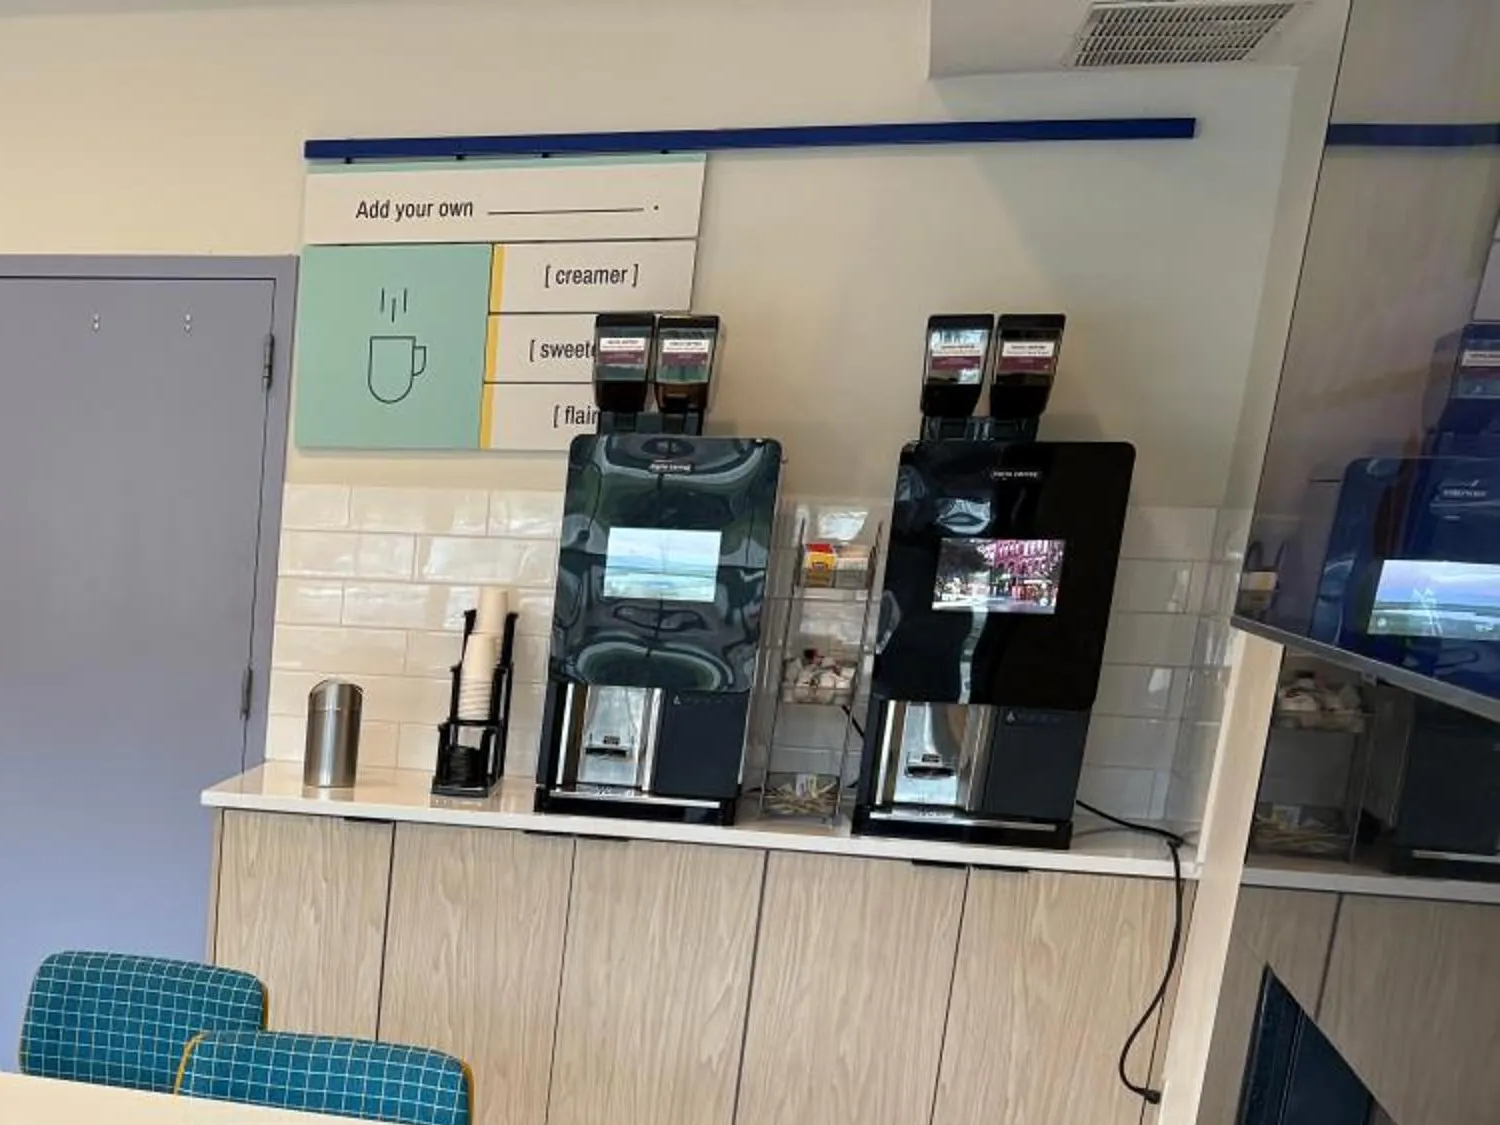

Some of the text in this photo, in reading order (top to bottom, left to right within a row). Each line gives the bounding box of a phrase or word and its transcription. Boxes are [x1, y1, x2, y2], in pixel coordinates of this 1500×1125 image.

[355, 199, 473, 222] Add your own
